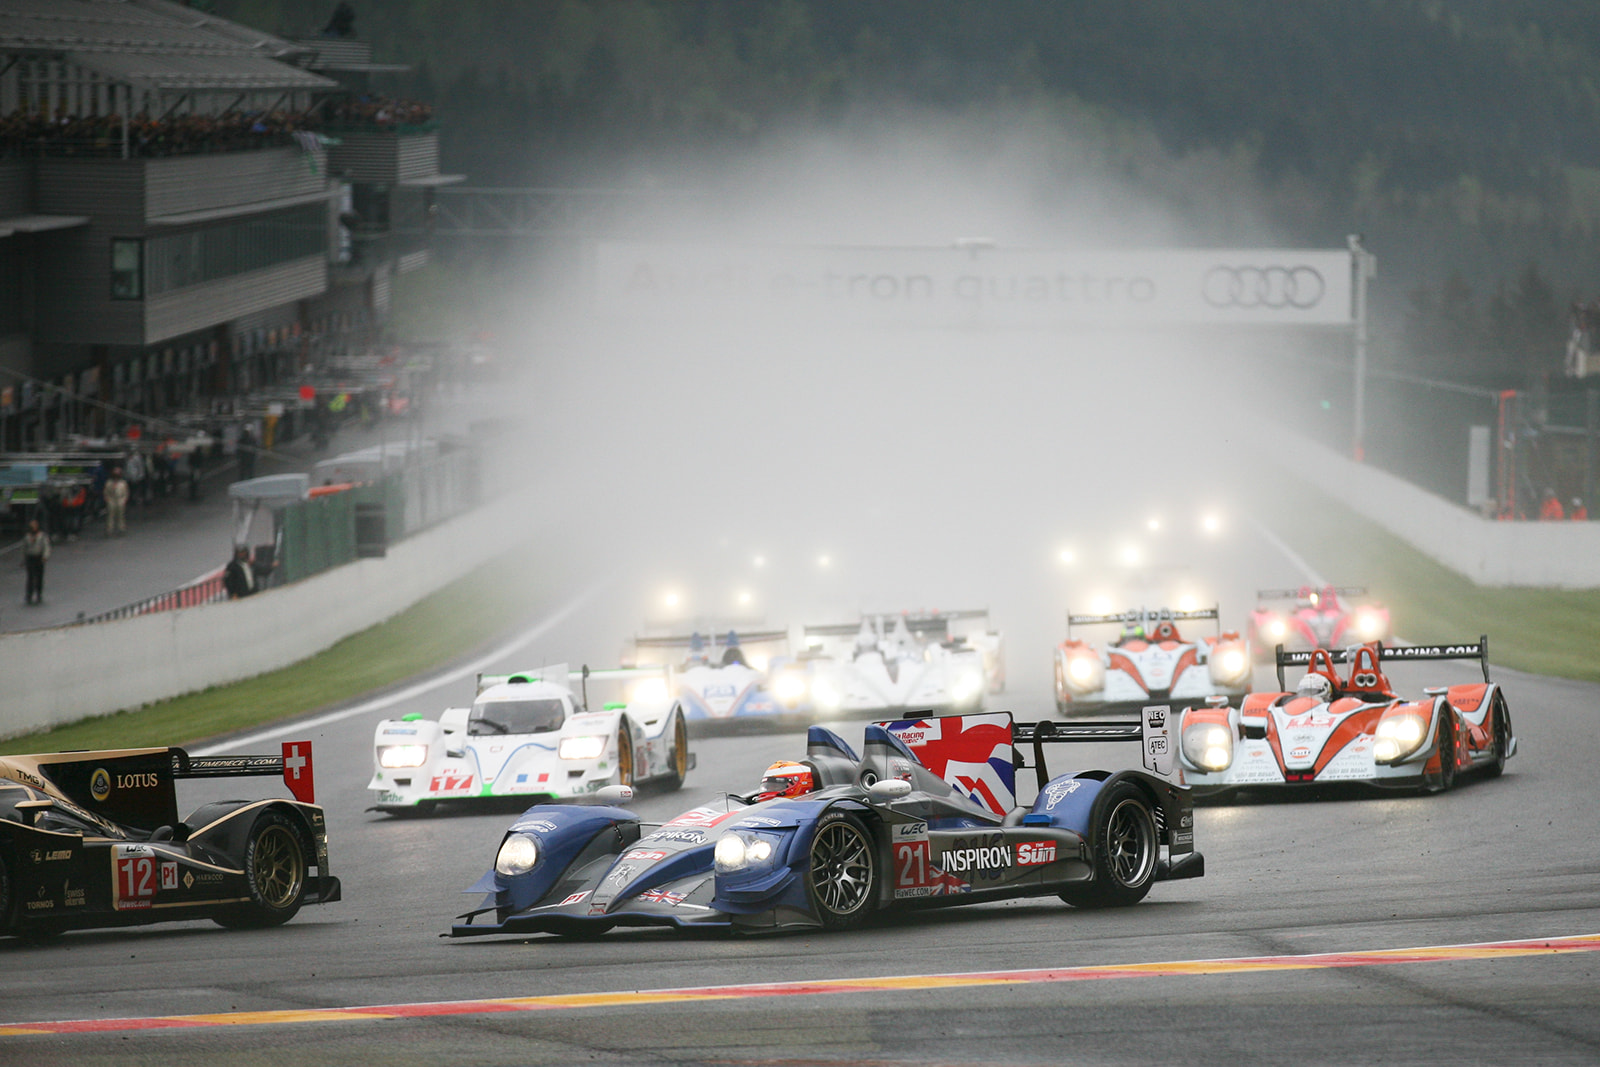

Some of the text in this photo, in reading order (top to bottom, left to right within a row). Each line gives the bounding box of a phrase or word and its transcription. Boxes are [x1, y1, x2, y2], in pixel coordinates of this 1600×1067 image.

[952, 270, 1158, 309] quattro
[1148, 710, 1165, 720] NEO
[902, 731, 925, 740] Racing
[1151, 740, 1165, 750] ATEC
[16, 769, 40, 785] TMG
[117, 773, 158, 789] LOTUS
[433, 776, 471, 791] 17
[572, 785, 585, 794] La
[901, 823, 925, 835] WEC
[942, 845, 1012, 873] INSPIRON
[1017, 844, 1056, 864] Sun
[900, 844, 925, 885] 21
[122, 859, 152, 896] 12
[163, 867, 175, 886] P1
